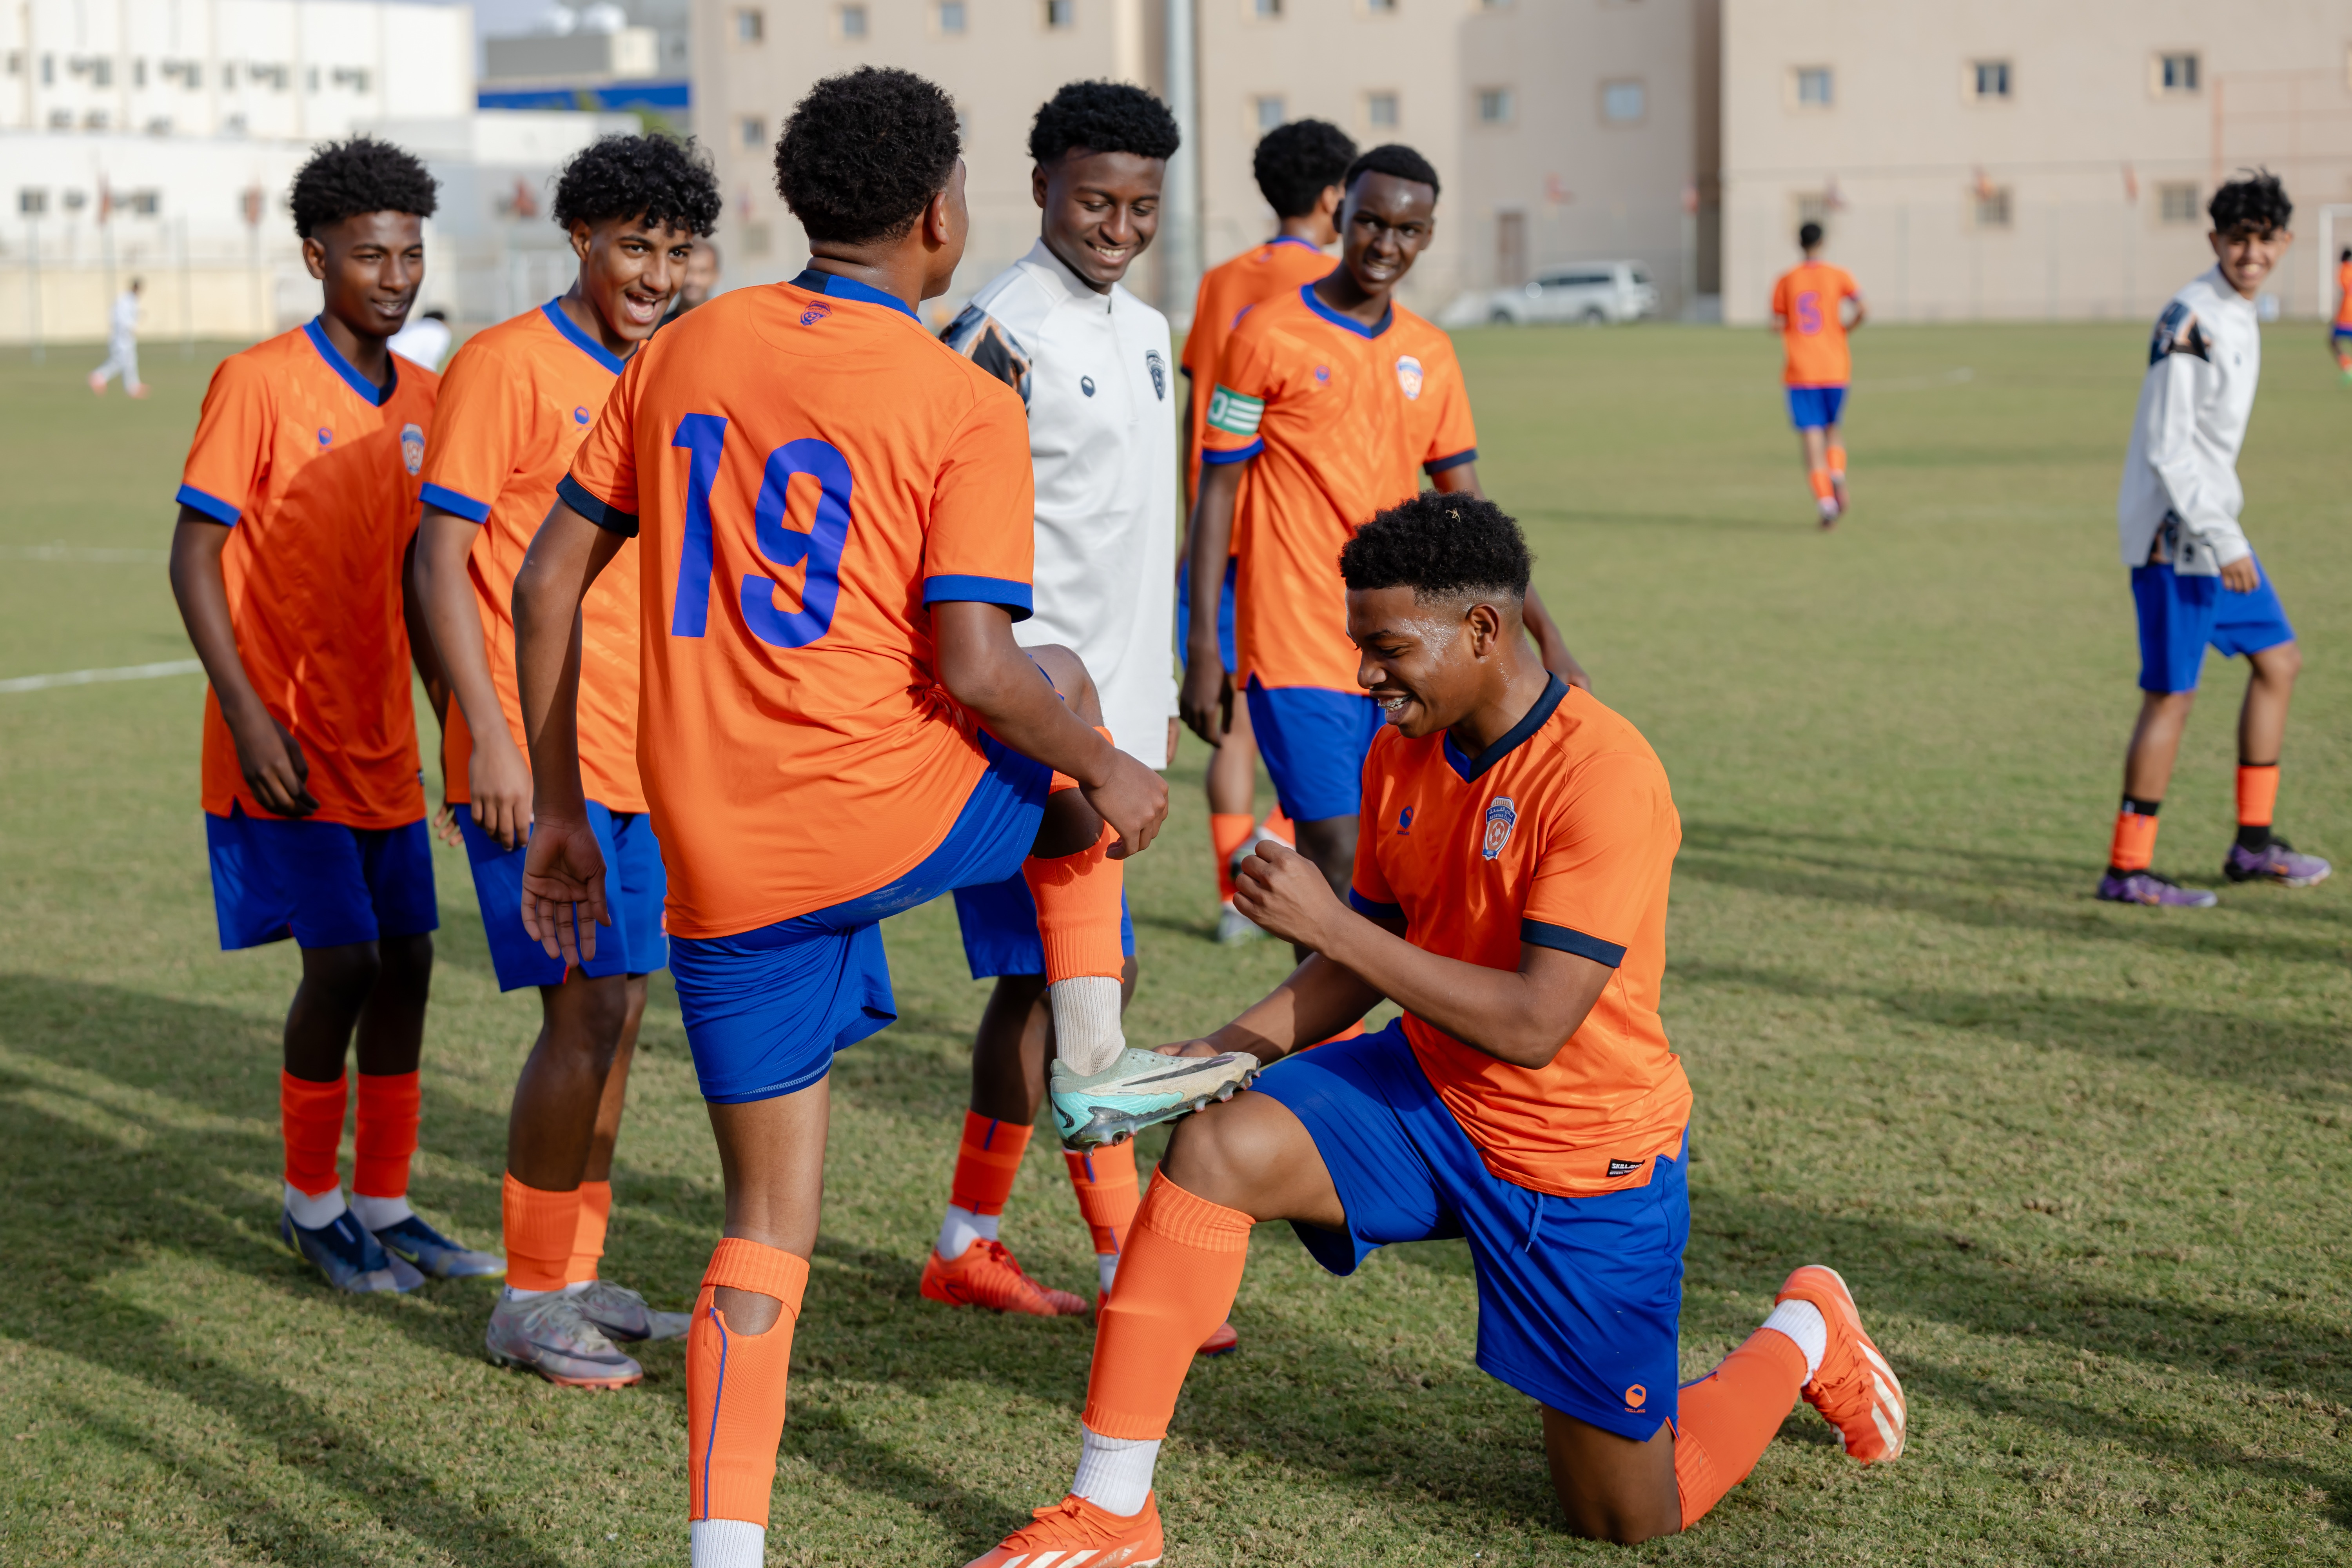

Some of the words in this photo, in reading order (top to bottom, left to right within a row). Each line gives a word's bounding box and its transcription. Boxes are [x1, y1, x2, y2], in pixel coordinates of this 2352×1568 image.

[1797, 291, 1822, 334] 5
[671, 413, 853, 648] 19
[1505, 809, 1514, 818] نادي
